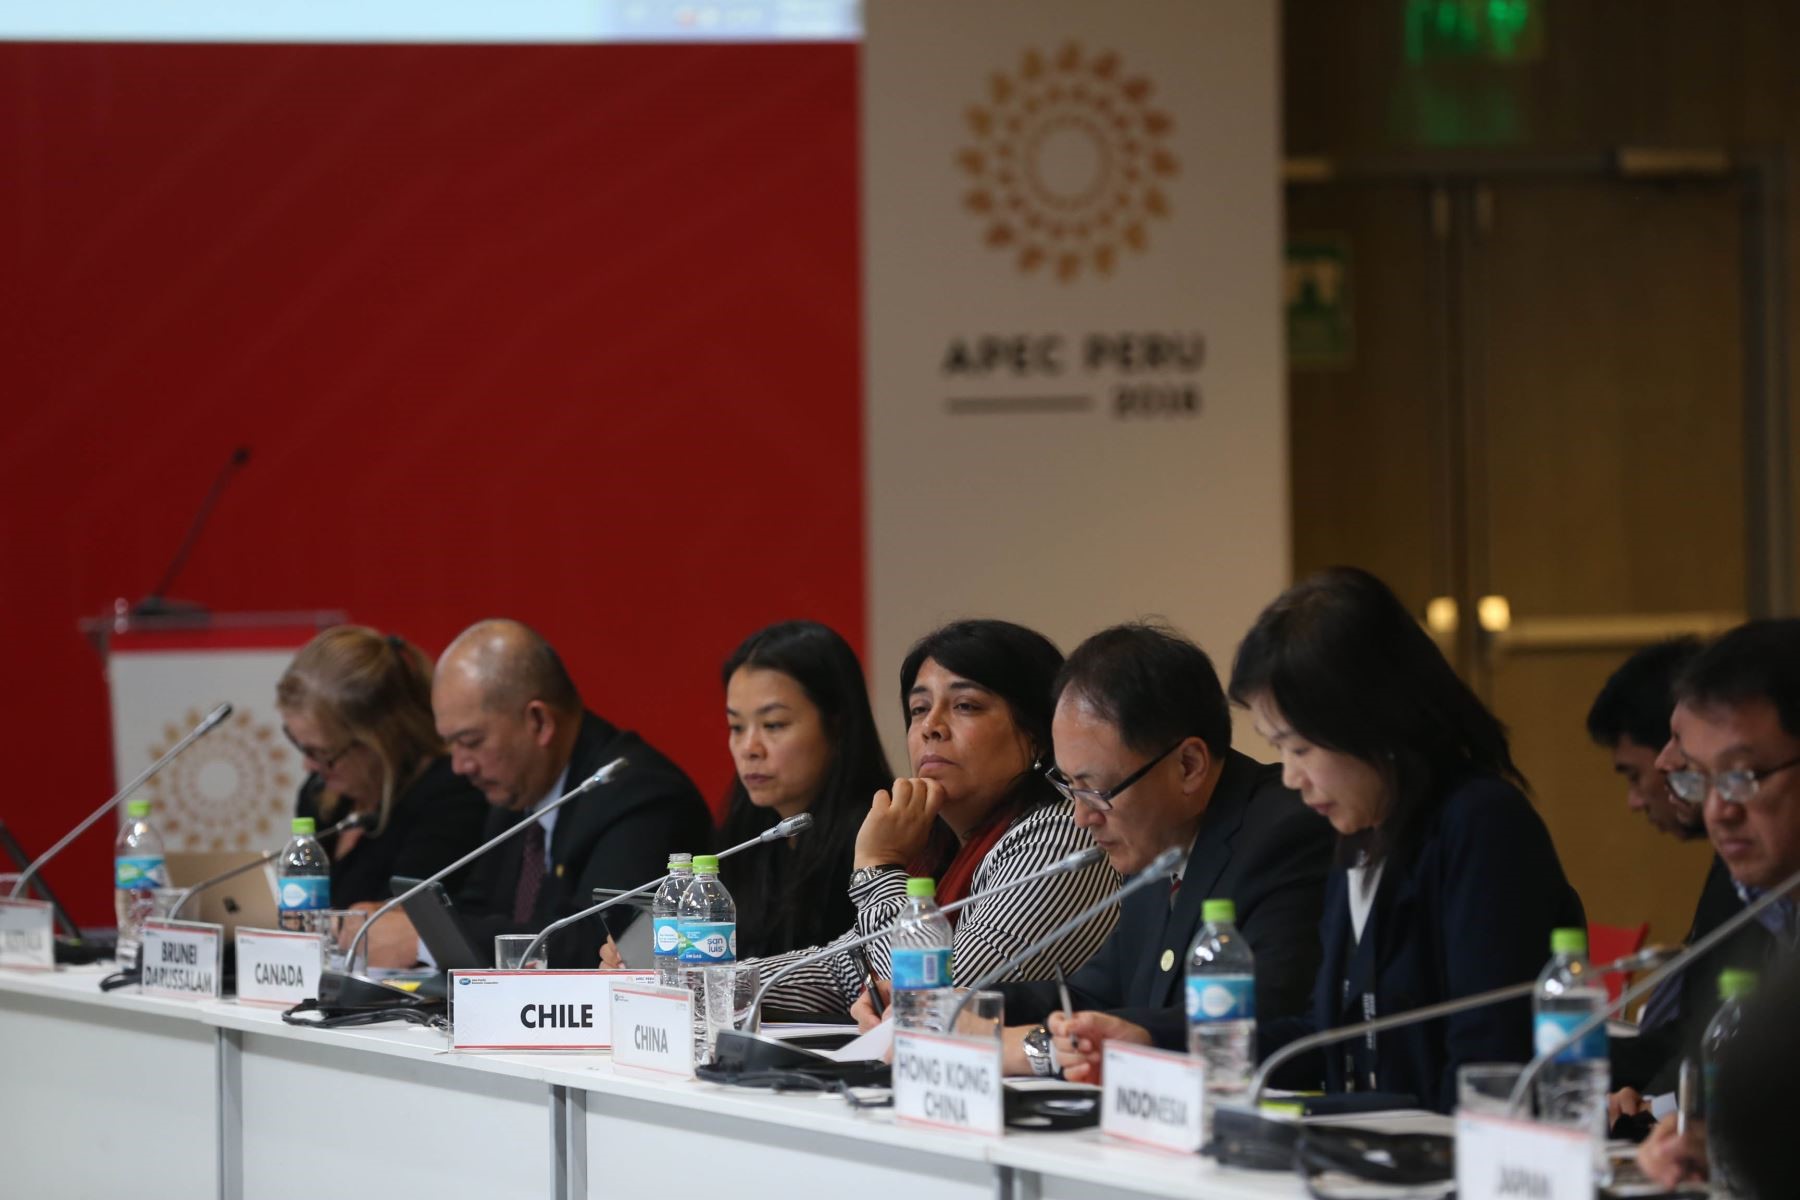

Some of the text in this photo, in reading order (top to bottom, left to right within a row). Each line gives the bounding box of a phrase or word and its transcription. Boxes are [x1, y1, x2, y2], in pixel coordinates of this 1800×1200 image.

[942, 332, 1206, 375] APEC PERU
[161, 941, 198, 966] BRUNEI
[708, 944, 724, 953] luis
[144, 966, 213, 993] DARUSSALAM
[254, 962, 305, 988] CANADA
[520, 1003, 593, 1029] CHILE
[634, 1024, 669, 1054] CHINA
[898, 1055, 991, 1095] HONG KONG
[924, 1091, 969, 1125] CHINA
[1116, 1086, 1188, 1126] INDONESIA
